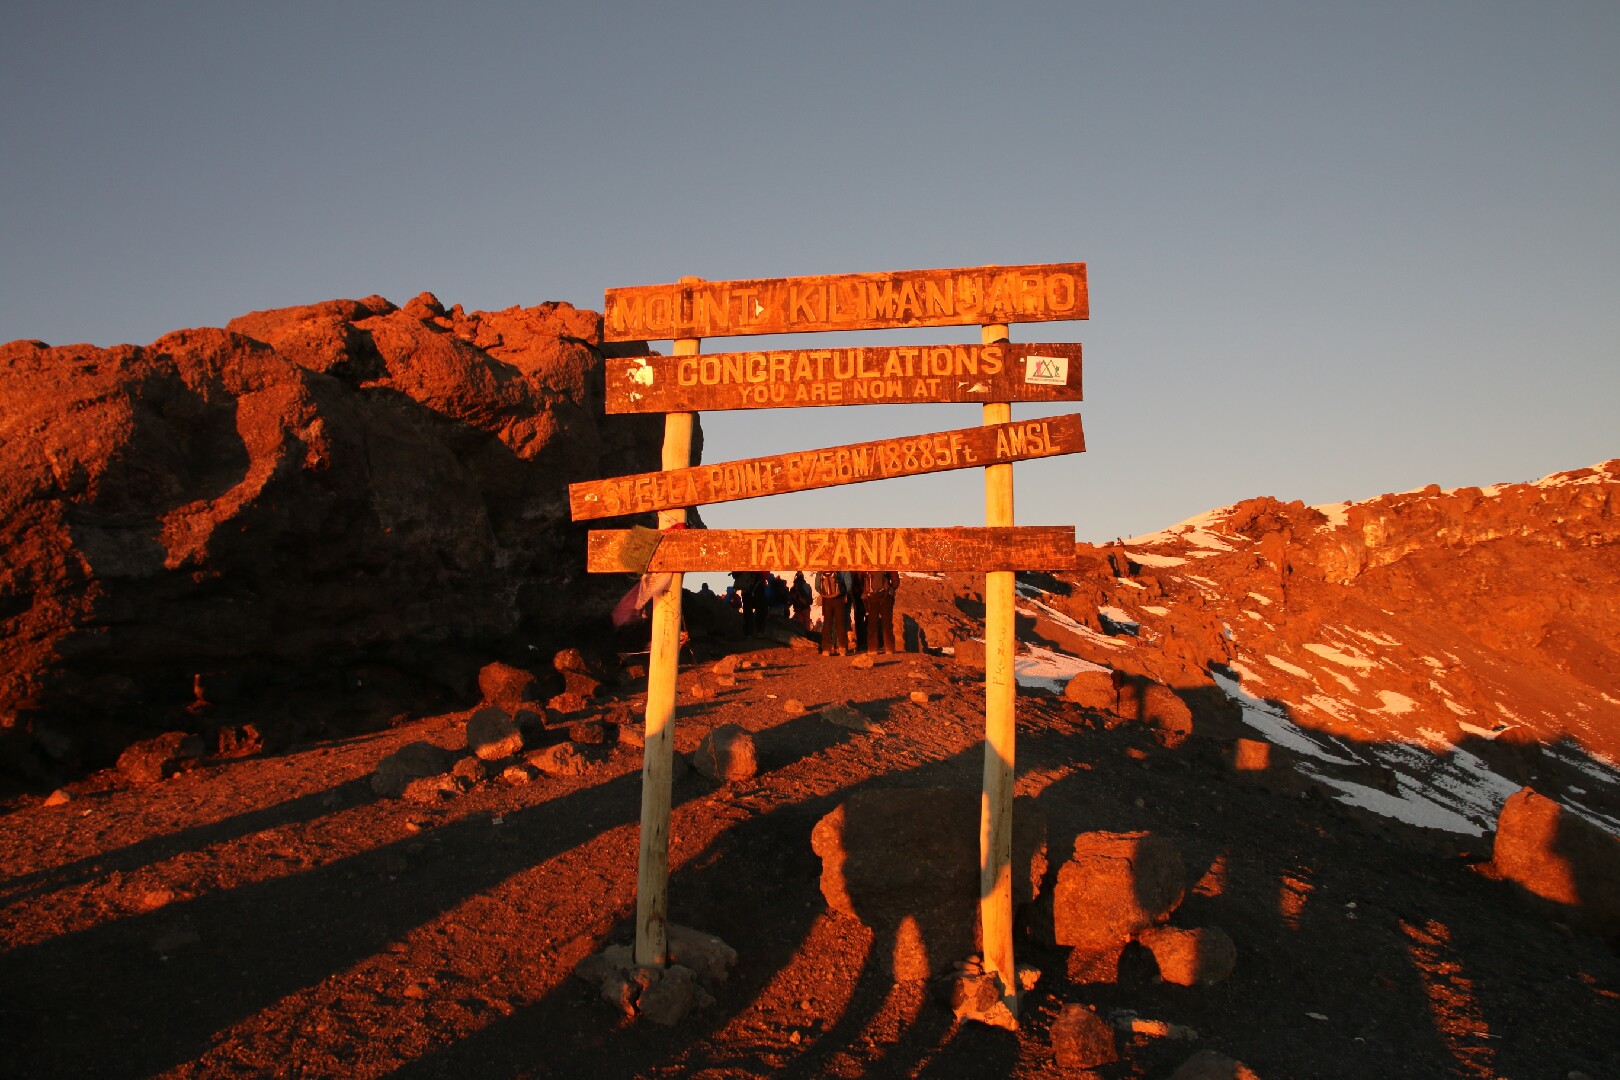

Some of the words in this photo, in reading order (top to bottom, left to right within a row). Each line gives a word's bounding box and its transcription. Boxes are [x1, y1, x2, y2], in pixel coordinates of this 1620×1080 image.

[612, 288, 759, 335] MOUNT
[789, 273, 1075, 324] KILIMANJARO
[677, 347, 1004, 386] CONGRATULATIONS
[738, 384, 785, 404] YOU
[795, 381, 843, 401] ARE
[853, 380, 903, 399] NOW
[914, 378, 941, 397] AT
[602, 472, 699, 512] STELLA
[709, 461, 776, 495] POINT
[996, 422, 1061, 458] AMSL
[748, 533, 910, 566] TANZANIA
